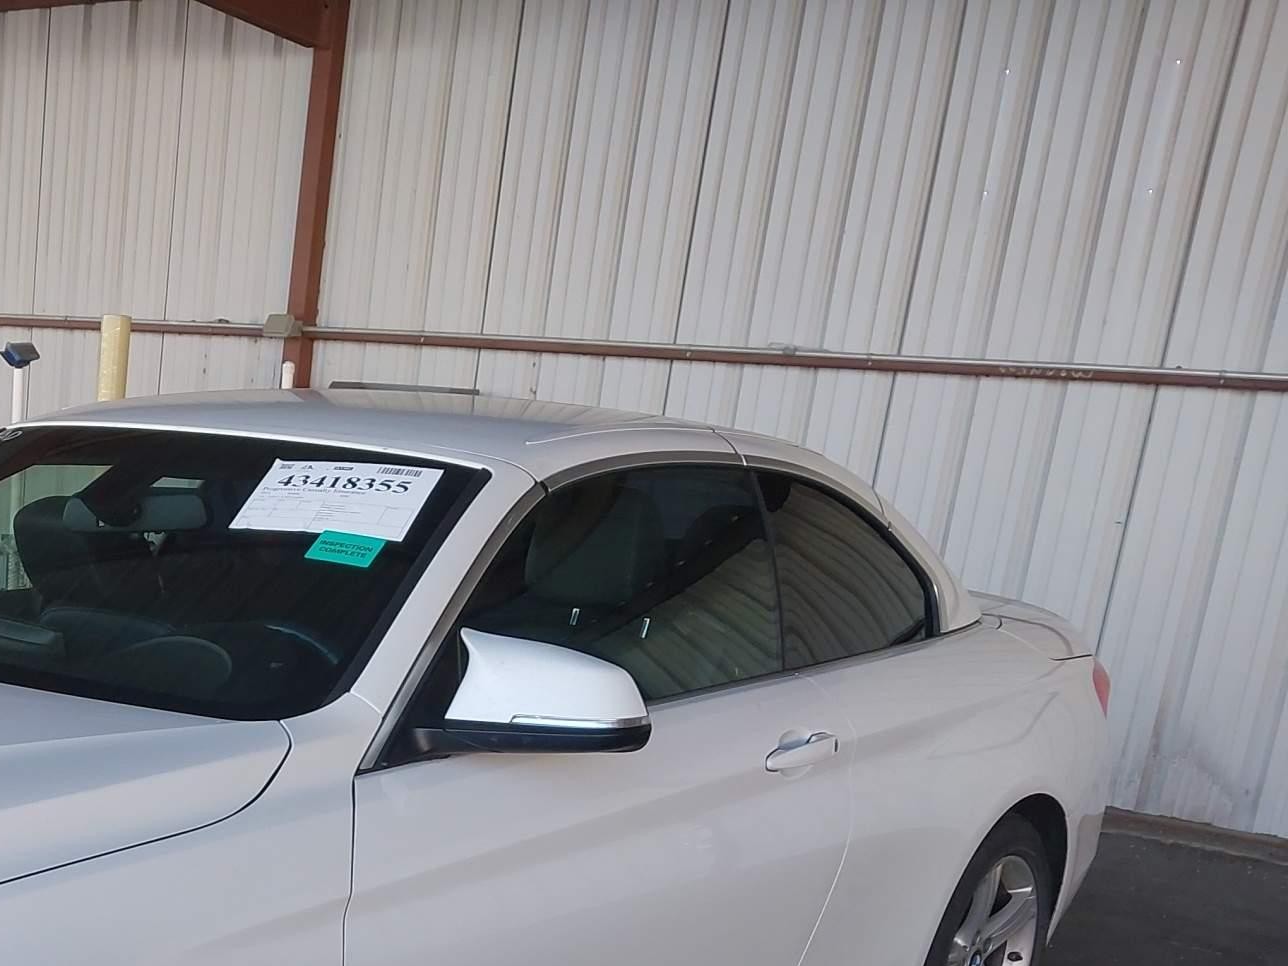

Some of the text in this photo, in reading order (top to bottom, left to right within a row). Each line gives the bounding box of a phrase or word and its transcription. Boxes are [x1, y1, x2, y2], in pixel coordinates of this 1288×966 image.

[278, 474, 412, 493] 43418355
[319, 546, 367, 558] COMPLETE
[320, 540, 374, 552] INSPECTION
